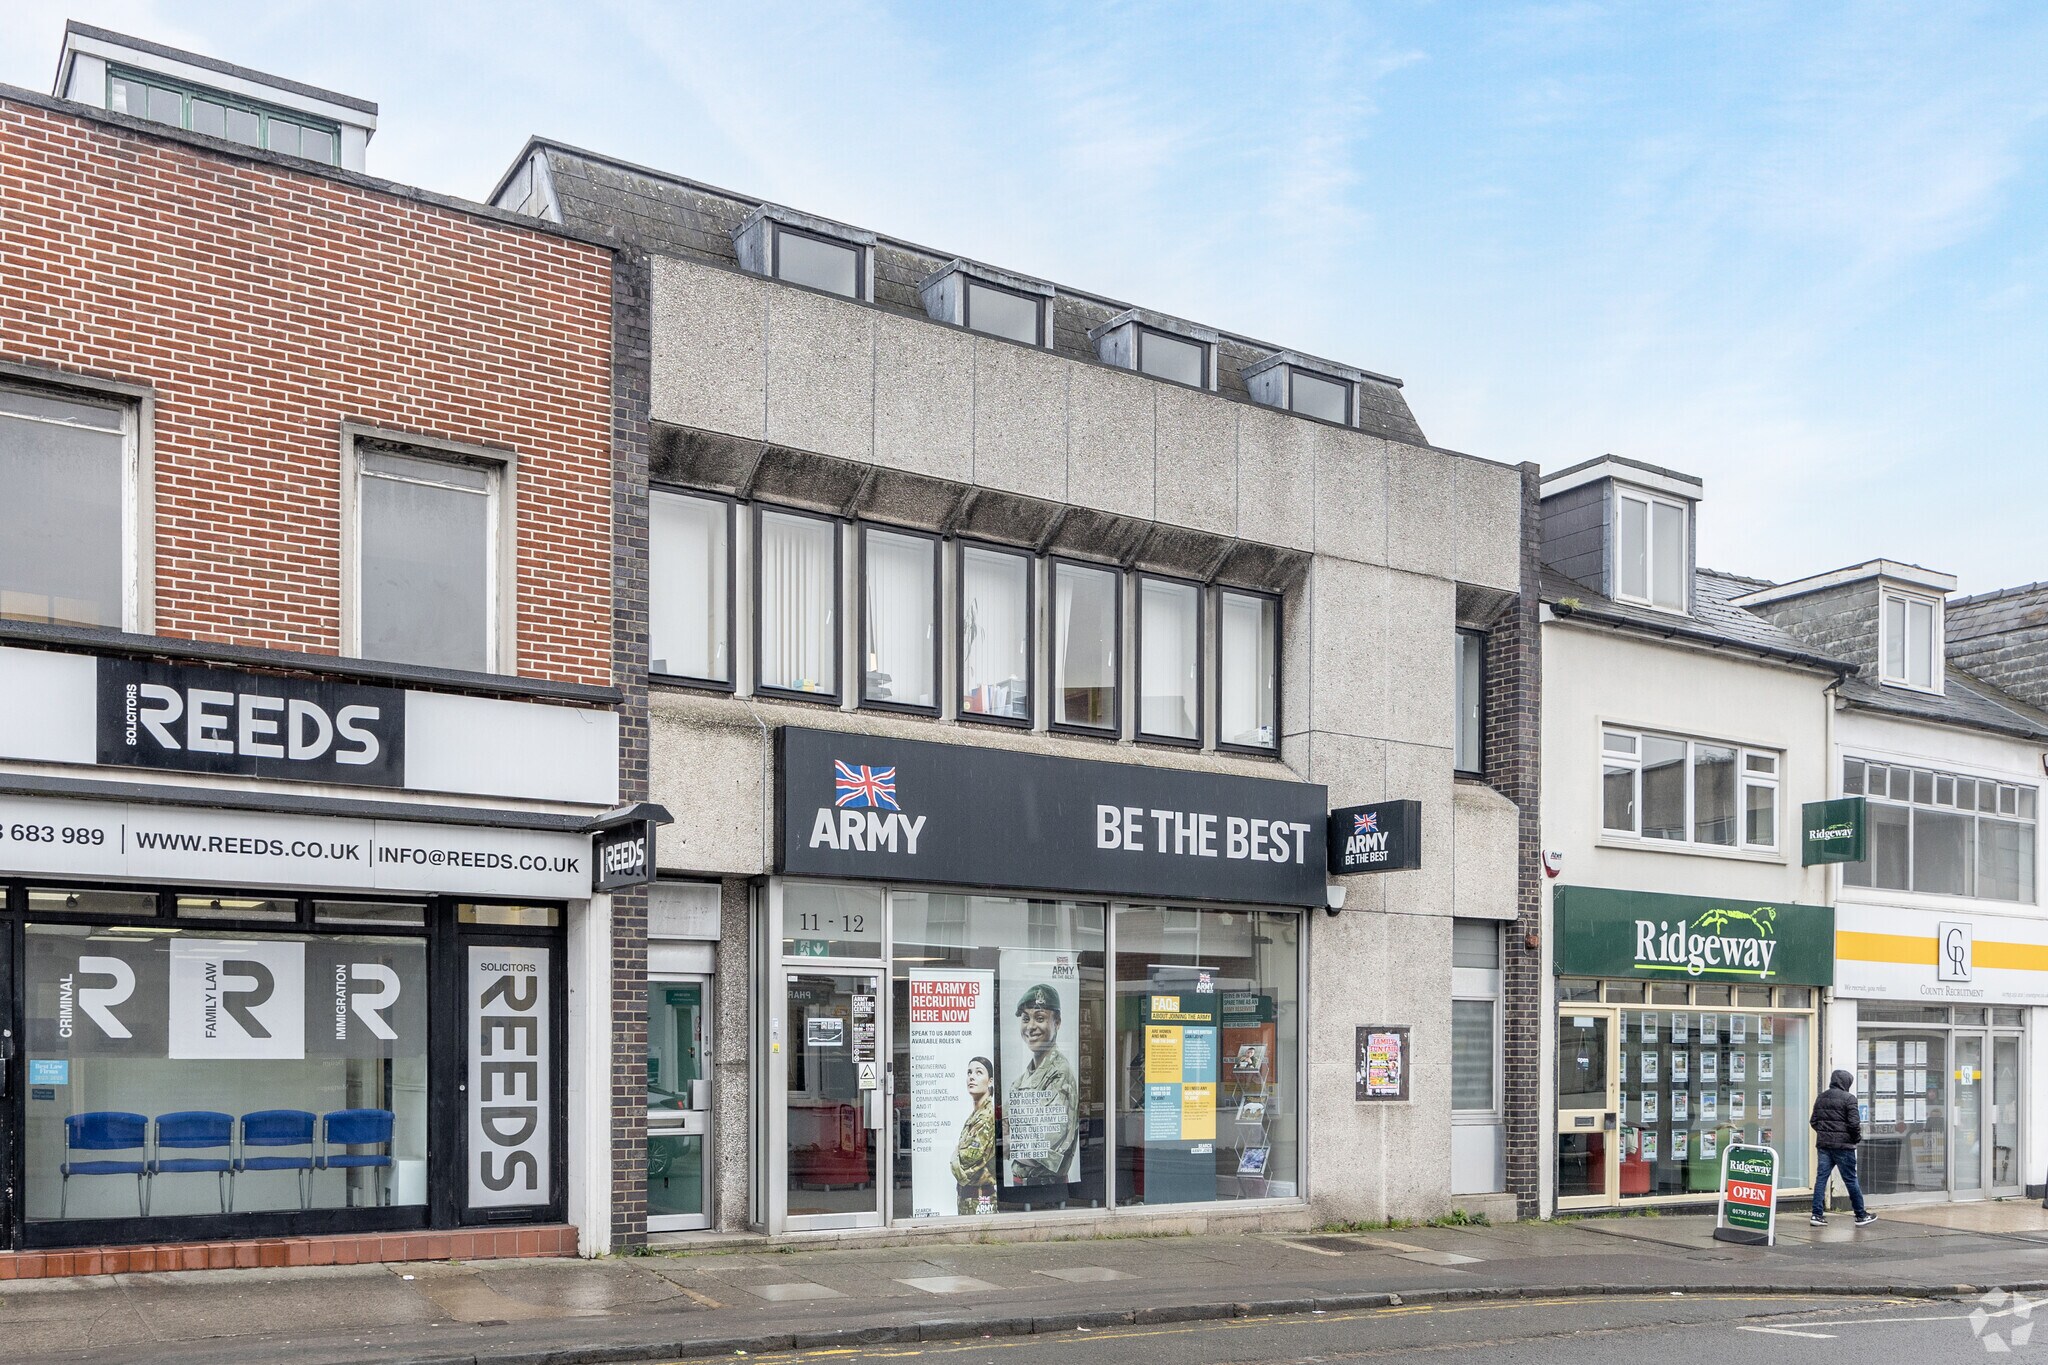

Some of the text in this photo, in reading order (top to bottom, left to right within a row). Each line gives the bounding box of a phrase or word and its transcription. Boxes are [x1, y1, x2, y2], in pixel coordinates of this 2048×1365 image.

[126, 684, 137, 745] SOLICITORS
[140, 684, 379, 765] REEDS
[10, 824, 55, 842] 683
[62, 827, 105, 845] 989
[809, 808, 927, 854] ARMY
[1098, 805, 1311, 864] BE THE BEST
[1809, 829, 1853, 840] Ridgeway
[136, 831, 360, 861] WWW.REEDS.CO.UK
[1345, 831, 1389, 855] ARMY
[378, 846, 580, 874] INFO@REEDS.CO.UK
[606, 838, 645, 872] REEDS
[1345, 850, 1389, 865] BE THE BEST
[800, 912, 820, 931] 11
[842, 914, 864, 933] 12
[1634, 919, 1777, 980] Ridgeway
[480, 962, 536, 973] SOLICITORS
[1052, 965, 1074, 975] ARMY
[912, 982, 979, 995] THE ARMY IS
[1196, 982, 1214, 990] ARMY
[59, 973, 73, 1038] CRIMINAL
[79, 956, 136, 1038] R
[205, 962, 217, 1038] FAMILY LAW
[222, 960, 275, 1038] R
[335, 964, 347, 1040] IMMIGRATION
[351, 963, 401, 1039] R
[912, 996, 975, 1008] RECRUITING
[1153, 997, 1179, 1010] FAQs
[912, 1009, 968, 1022] HERE NOW
[480, 975, 538, 1192] REEDS
[1010, 1090, 1052, 1099] EXPLORE OVER
[1028, 1125, 1060, 1133] QUESTIONS
[1030, 1141, 1050, 1149] INSIDE
[1032, 1150, 1047, 1158] BEST
[1730, 1160, 1772, 1176] Ridgeway
[1733, 1185, 1766, 1201] OPEN
[976, 1205, 994, 1214] ARMY
[1732, 1208, 1747, 1216] 01793
